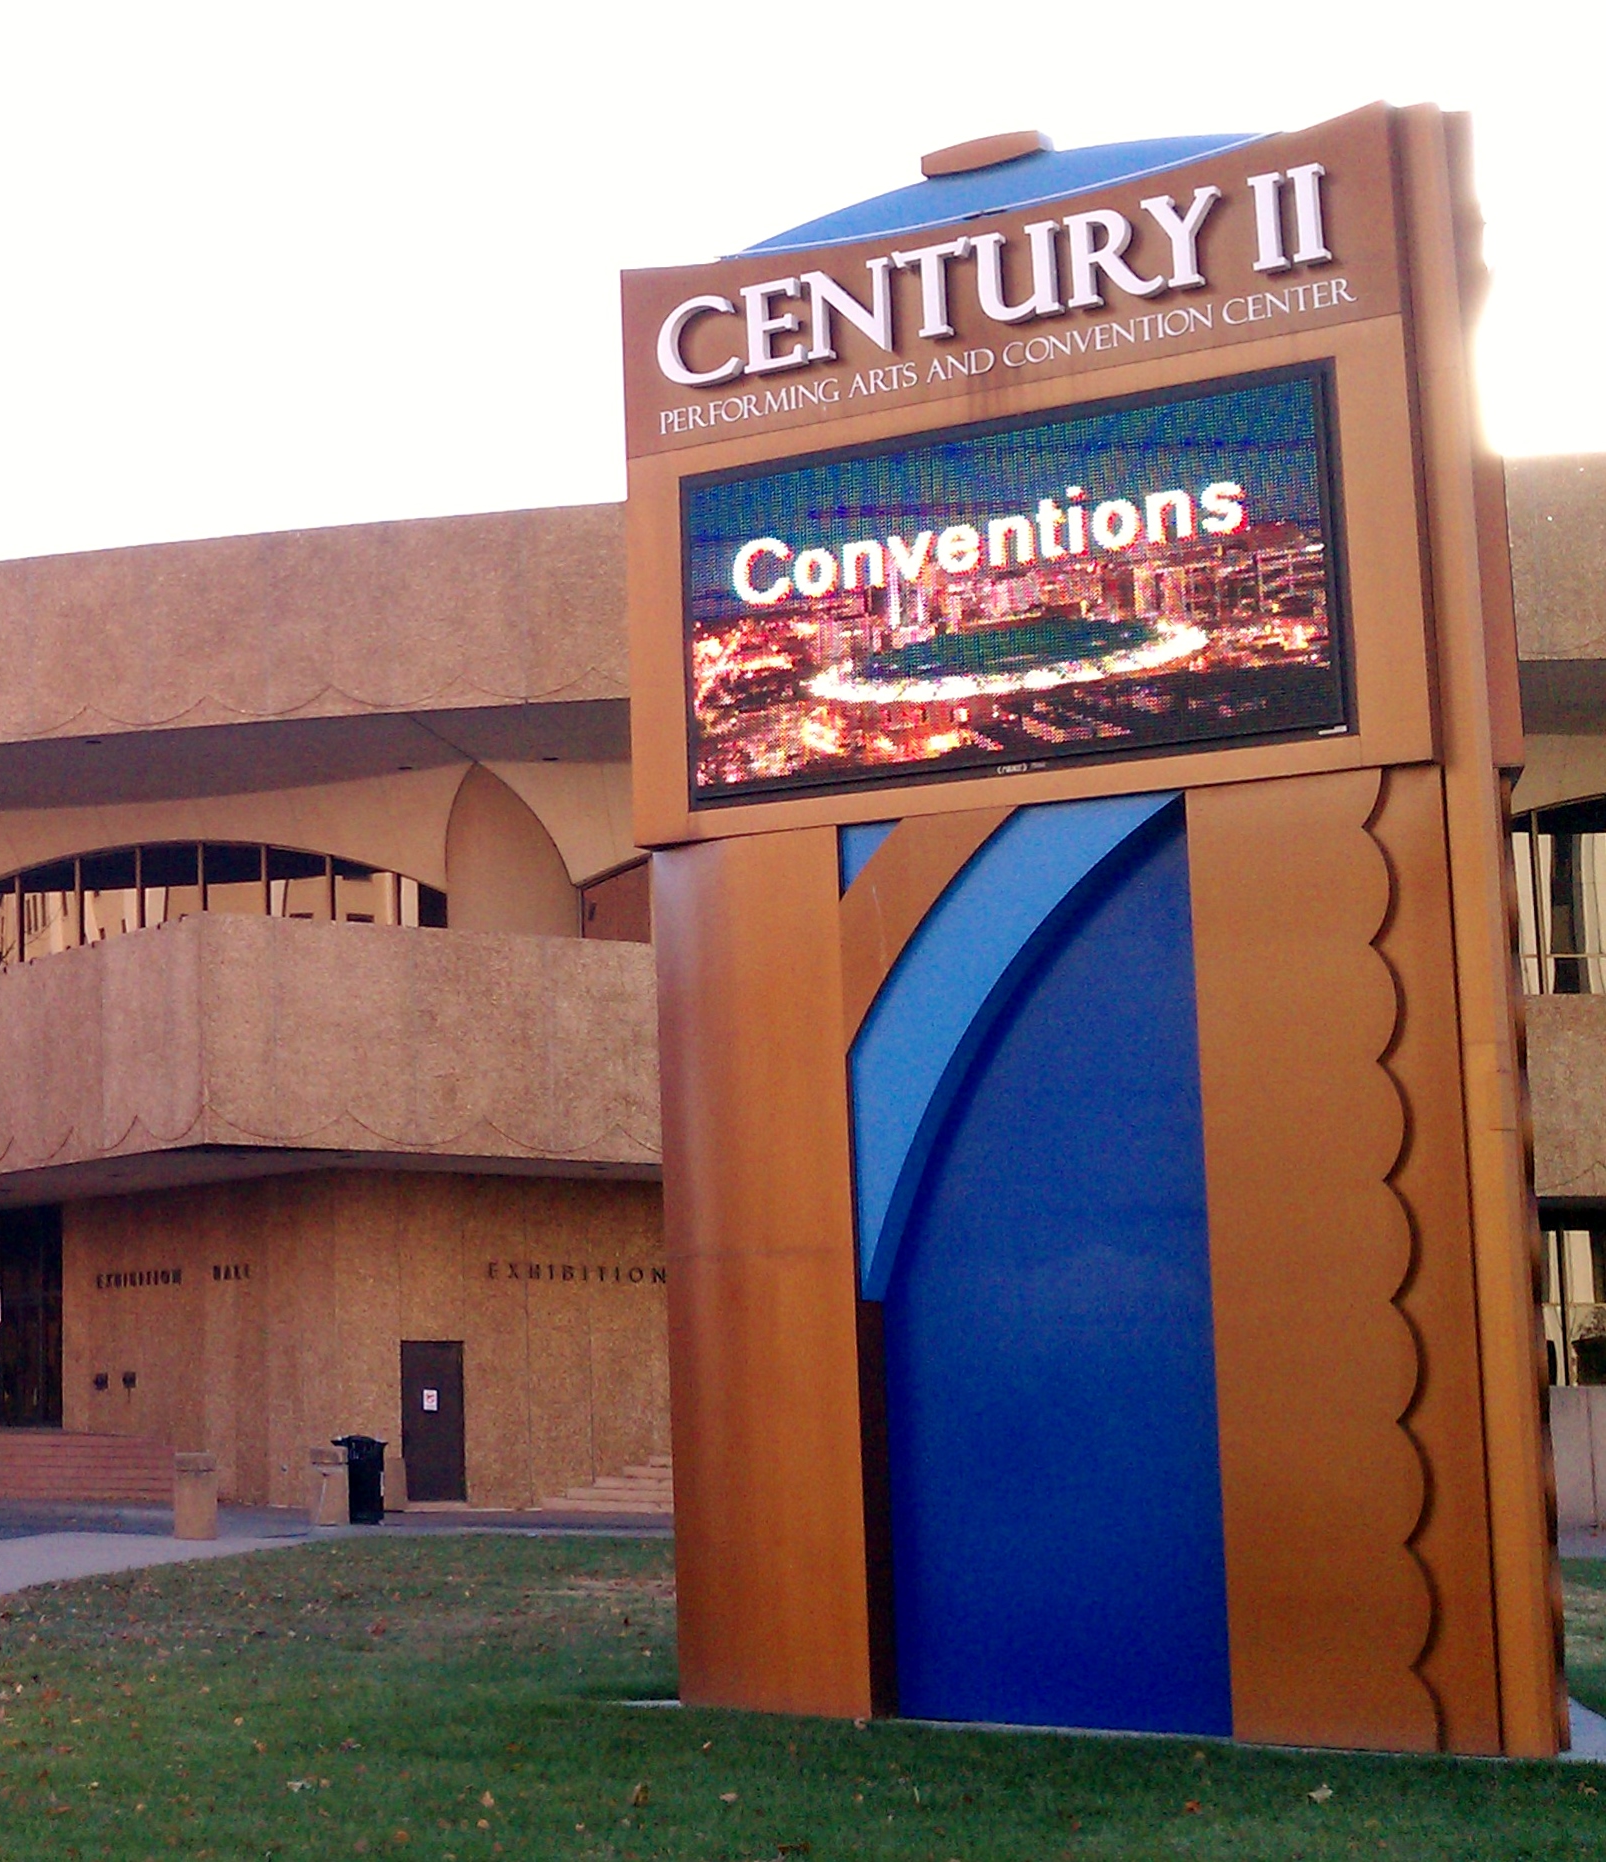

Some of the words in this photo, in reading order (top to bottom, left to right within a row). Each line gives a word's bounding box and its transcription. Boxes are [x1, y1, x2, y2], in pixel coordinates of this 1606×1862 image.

[656, 184, 1221, 387] CENTURY
[1247, 162, 1332, 274] II
[659, 377, 841, 436] PERFORMING
[848, 361, 919, 400] ARTS
[925, 347, 995, 384] AND
[1001, 302, 1215, 369] CONVENTION
[1221, 276, 1358, 326] CENTER
[731, 479, 1249, 604] Conventions
[487, 1261, 667, 1284] EXHIBITION
